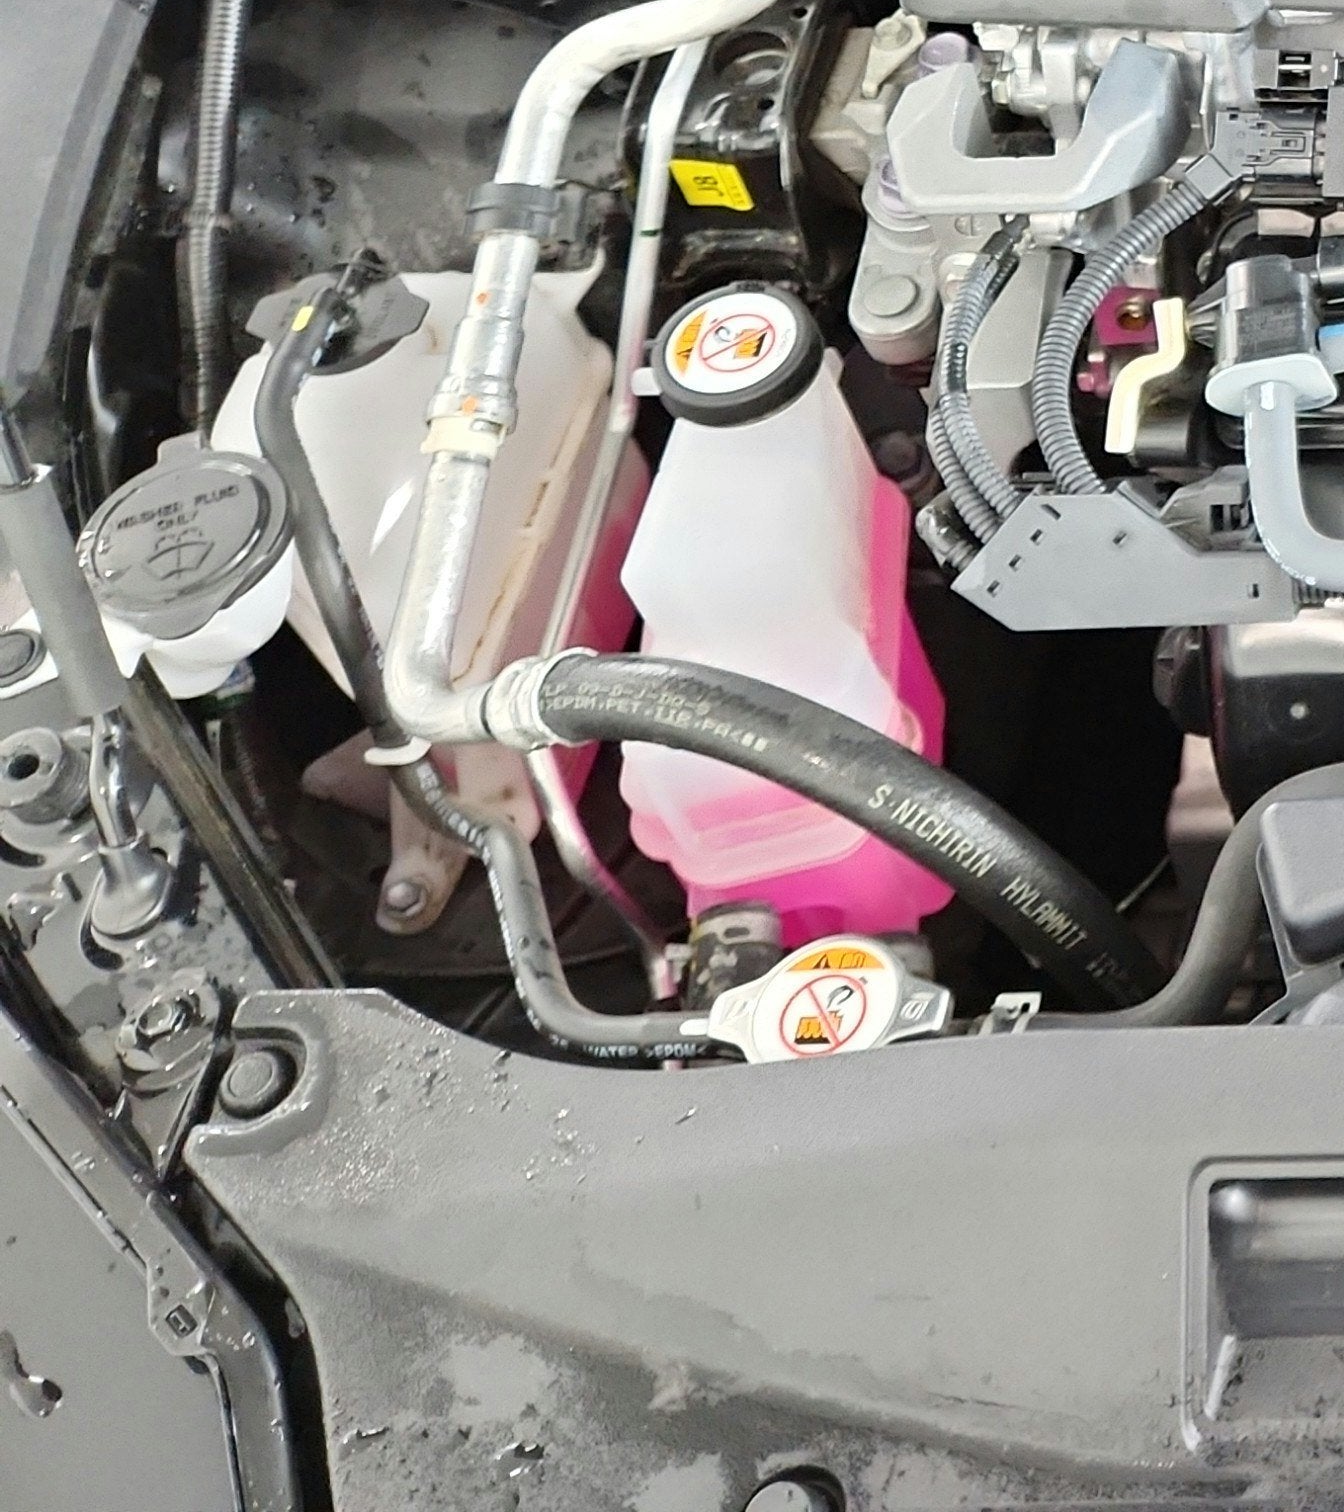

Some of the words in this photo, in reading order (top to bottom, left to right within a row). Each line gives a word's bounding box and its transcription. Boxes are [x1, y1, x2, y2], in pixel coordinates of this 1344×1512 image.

[117, 500, 184, 530] WASHER
[194, 484, 241, 507] FLUID
[157, 509, 199, 531] ONLY
[999, 875, 1089, 951] HYLAMMIT
